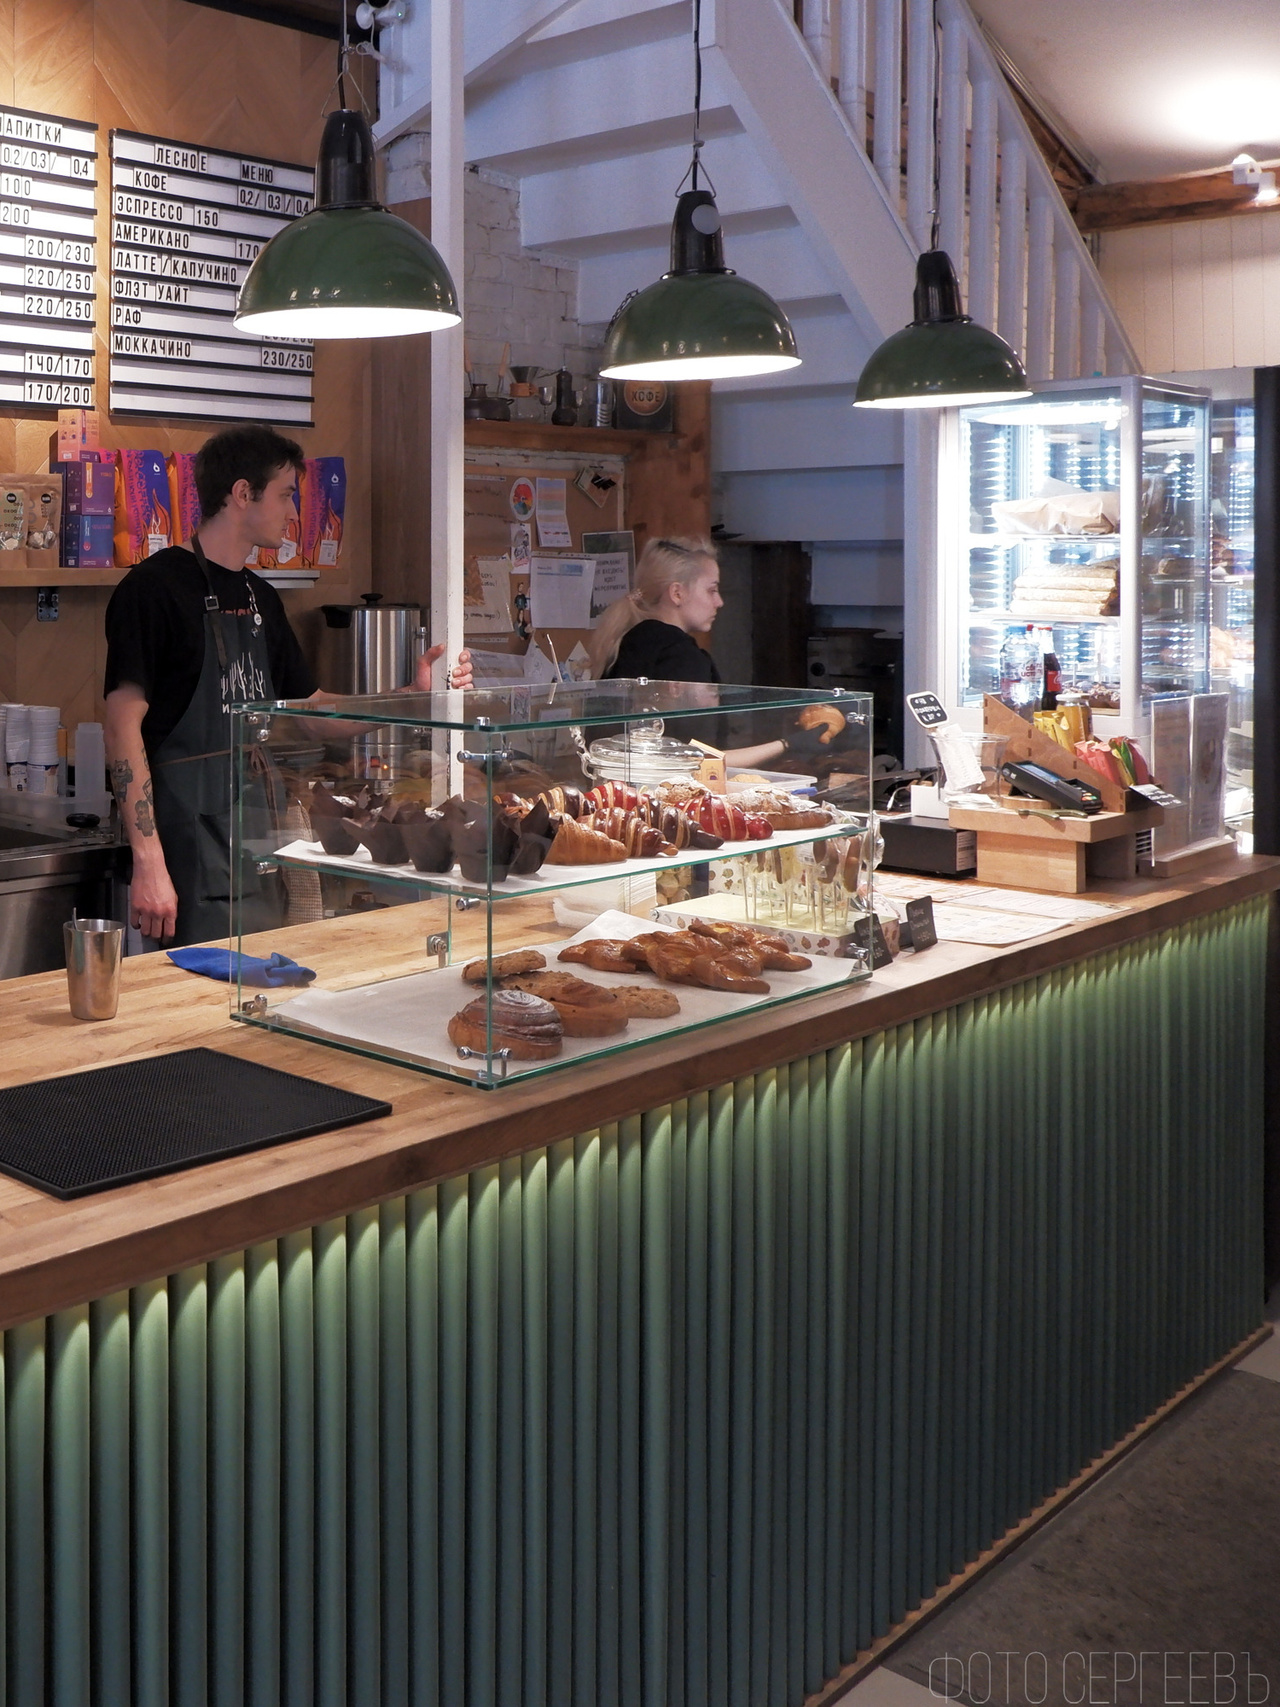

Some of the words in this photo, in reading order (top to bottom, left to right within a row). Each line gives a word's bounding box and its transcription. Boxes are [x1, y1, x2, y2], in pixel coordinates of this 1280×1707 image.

[156, 147, 208, 171] ЛЕСНОЕ
[242, 164, 274, 183] МЕНЮ
[5, 177, 31, 196] 100
[135, 171, 168, 191] КОФЕ
[3, 206, 30, 225] 200
[117, 196, 183, 221] ЭСПРЕССО
[197, 209, 219, 227] 150
[115, 223, 190, 249] АМЕРИКАНО
[28, 239, 91, 263] 200/230
[27, 267, 91, 291] 220/250
[115, 279, 149, 296] ФЛЭТ
[158, 284, 189, 303] УАЙТ
[27, 297, 91, 319] 220/250
[115, 307, 142, 325] РАФ
[115, 335, 192, 358] МОККАЧИНО
[263, 350, 312, 369] 230/250
[28, 354, 90, 376] 140/170
[27, 384, 90, 404] 170/200
